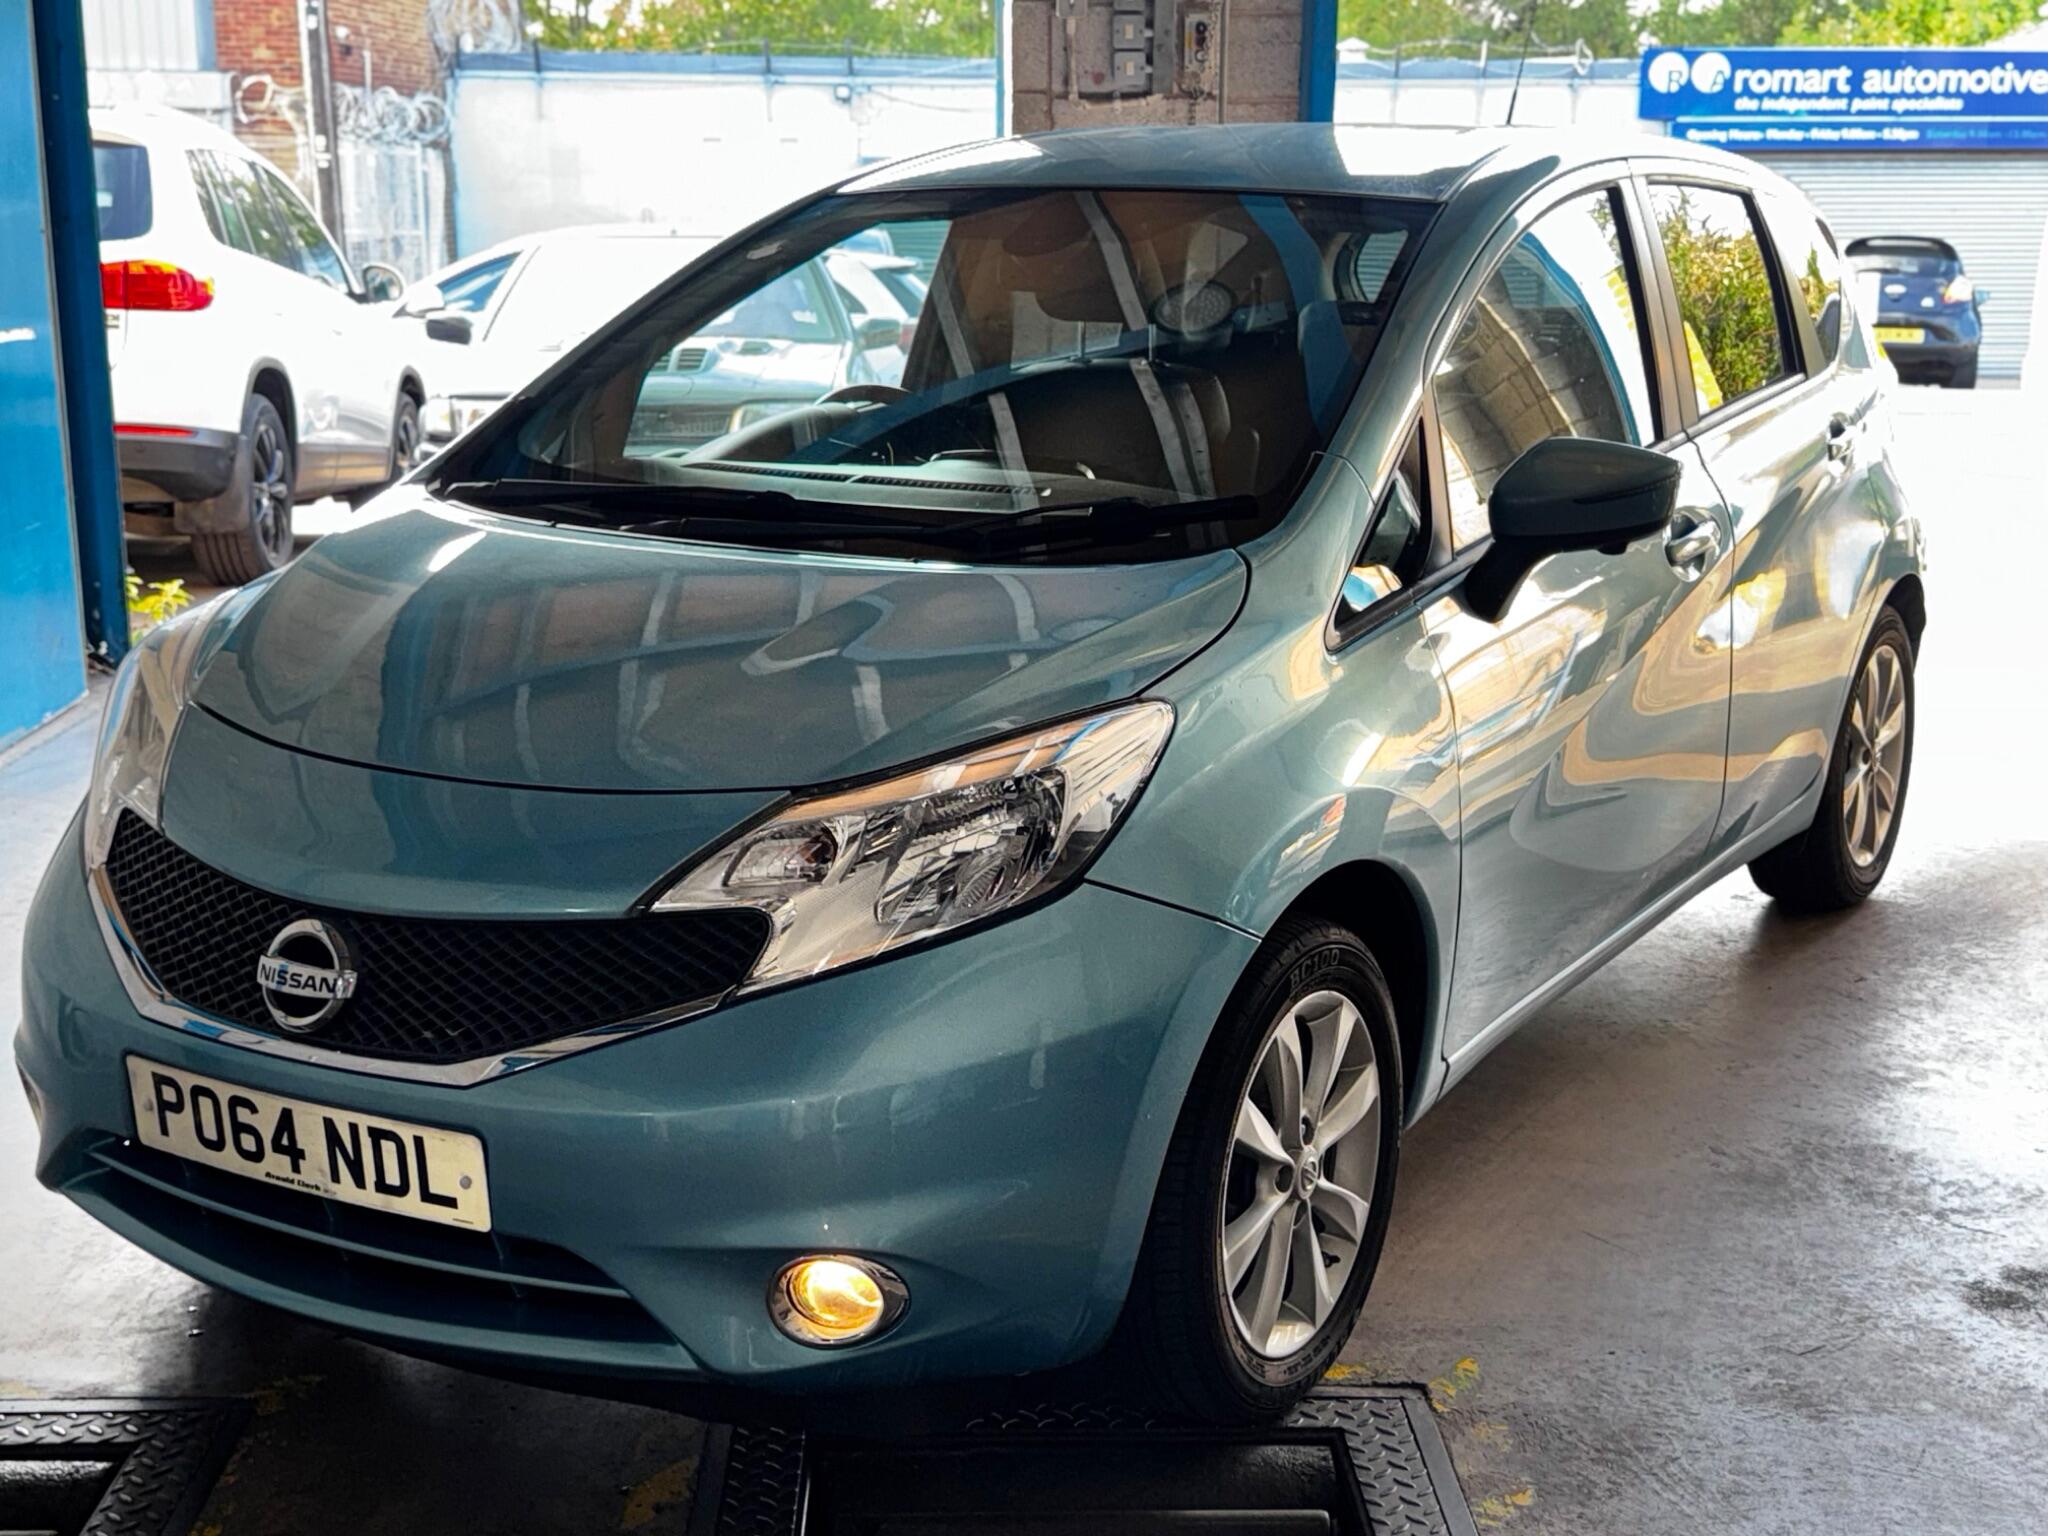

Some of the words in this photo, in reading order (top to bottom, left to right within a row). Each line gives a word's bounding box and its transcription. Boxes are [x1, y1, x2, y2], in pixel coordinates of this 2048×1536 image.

[1733, 65, 1853, 94] romart
[1862, 61, 2048, 94] automotive
[1734, 96, 1760, 111] the
[260, 963, 338, 994] NISSAN
[151, 1070, 306, 1174] PO64
[322, 1116, 458, 1209] NDL
